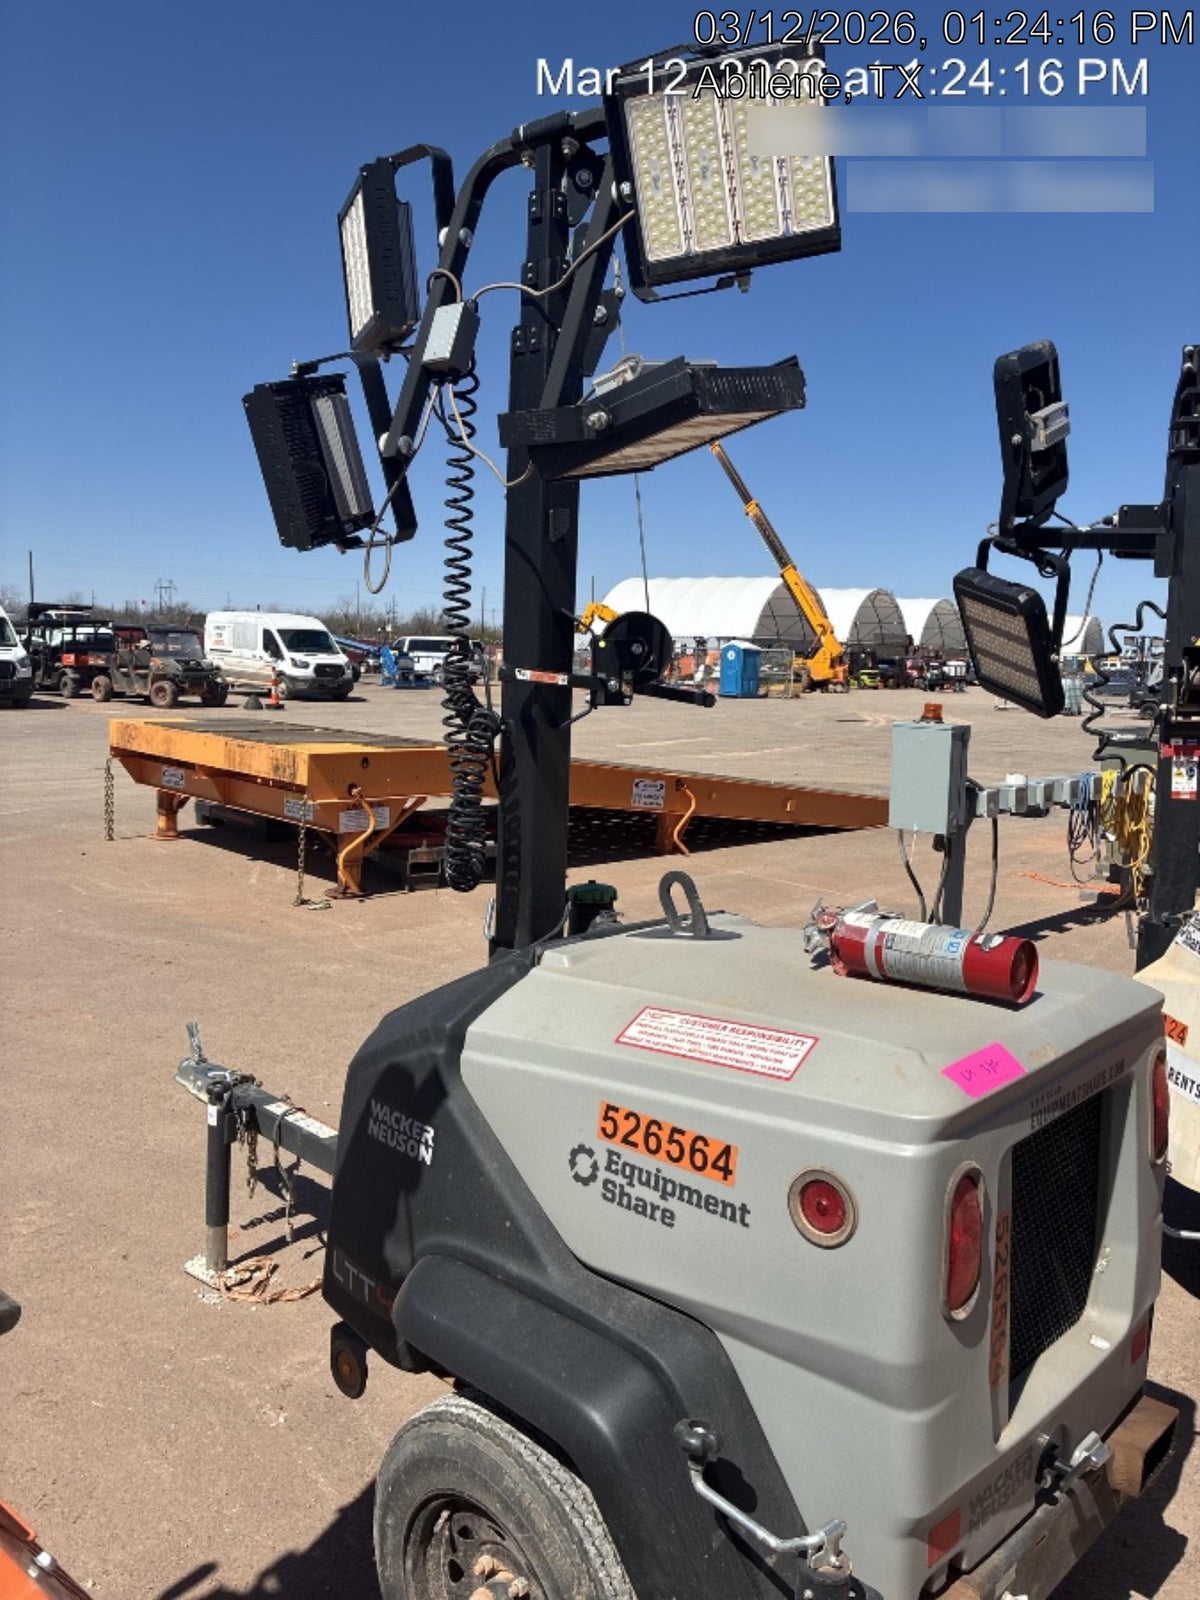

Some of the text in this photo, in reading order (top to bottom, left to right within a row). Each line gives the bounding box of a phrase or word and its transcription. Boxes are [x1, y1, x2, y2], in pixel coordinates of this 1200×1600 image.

[1163, 1013, 1188, 1046] 24
[368, 1118, 433, 1166] NEUSON
[370, 1099, 435, 1148] WACKER
[600, 1103, 734, 1182] 526564
[601, 1177, 676, 1229] Share
[603, 1148, 752, 1229] Equipment
